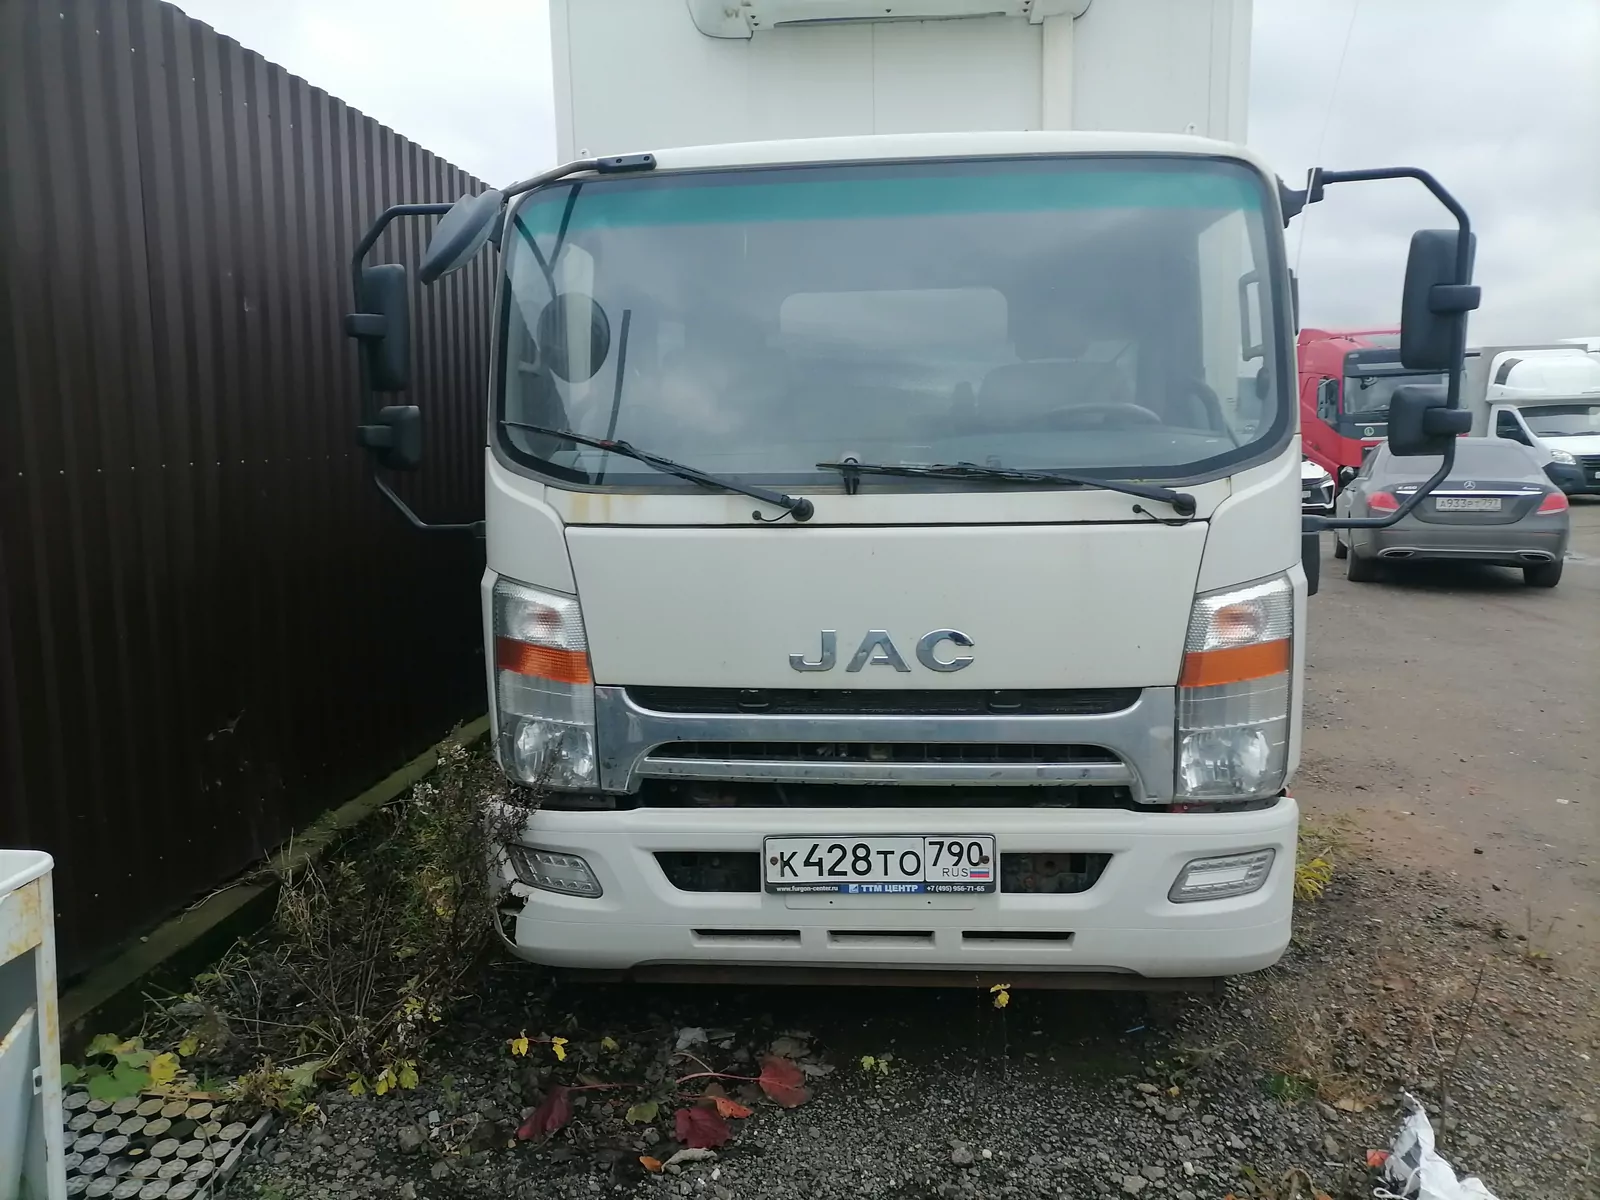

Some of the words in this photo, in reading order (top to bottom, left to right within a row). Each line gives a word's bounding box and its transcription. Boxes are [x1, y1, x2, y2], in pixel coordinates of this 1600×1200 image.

[788, 628, 975, 673] JAC
[928, 841, 984, 867] 790
[942, 867, 969, 878] RUS
[776, 885, 839, 893] www.furgon-center.ru
[884, 884, 919, 893] ЦЕНТР
